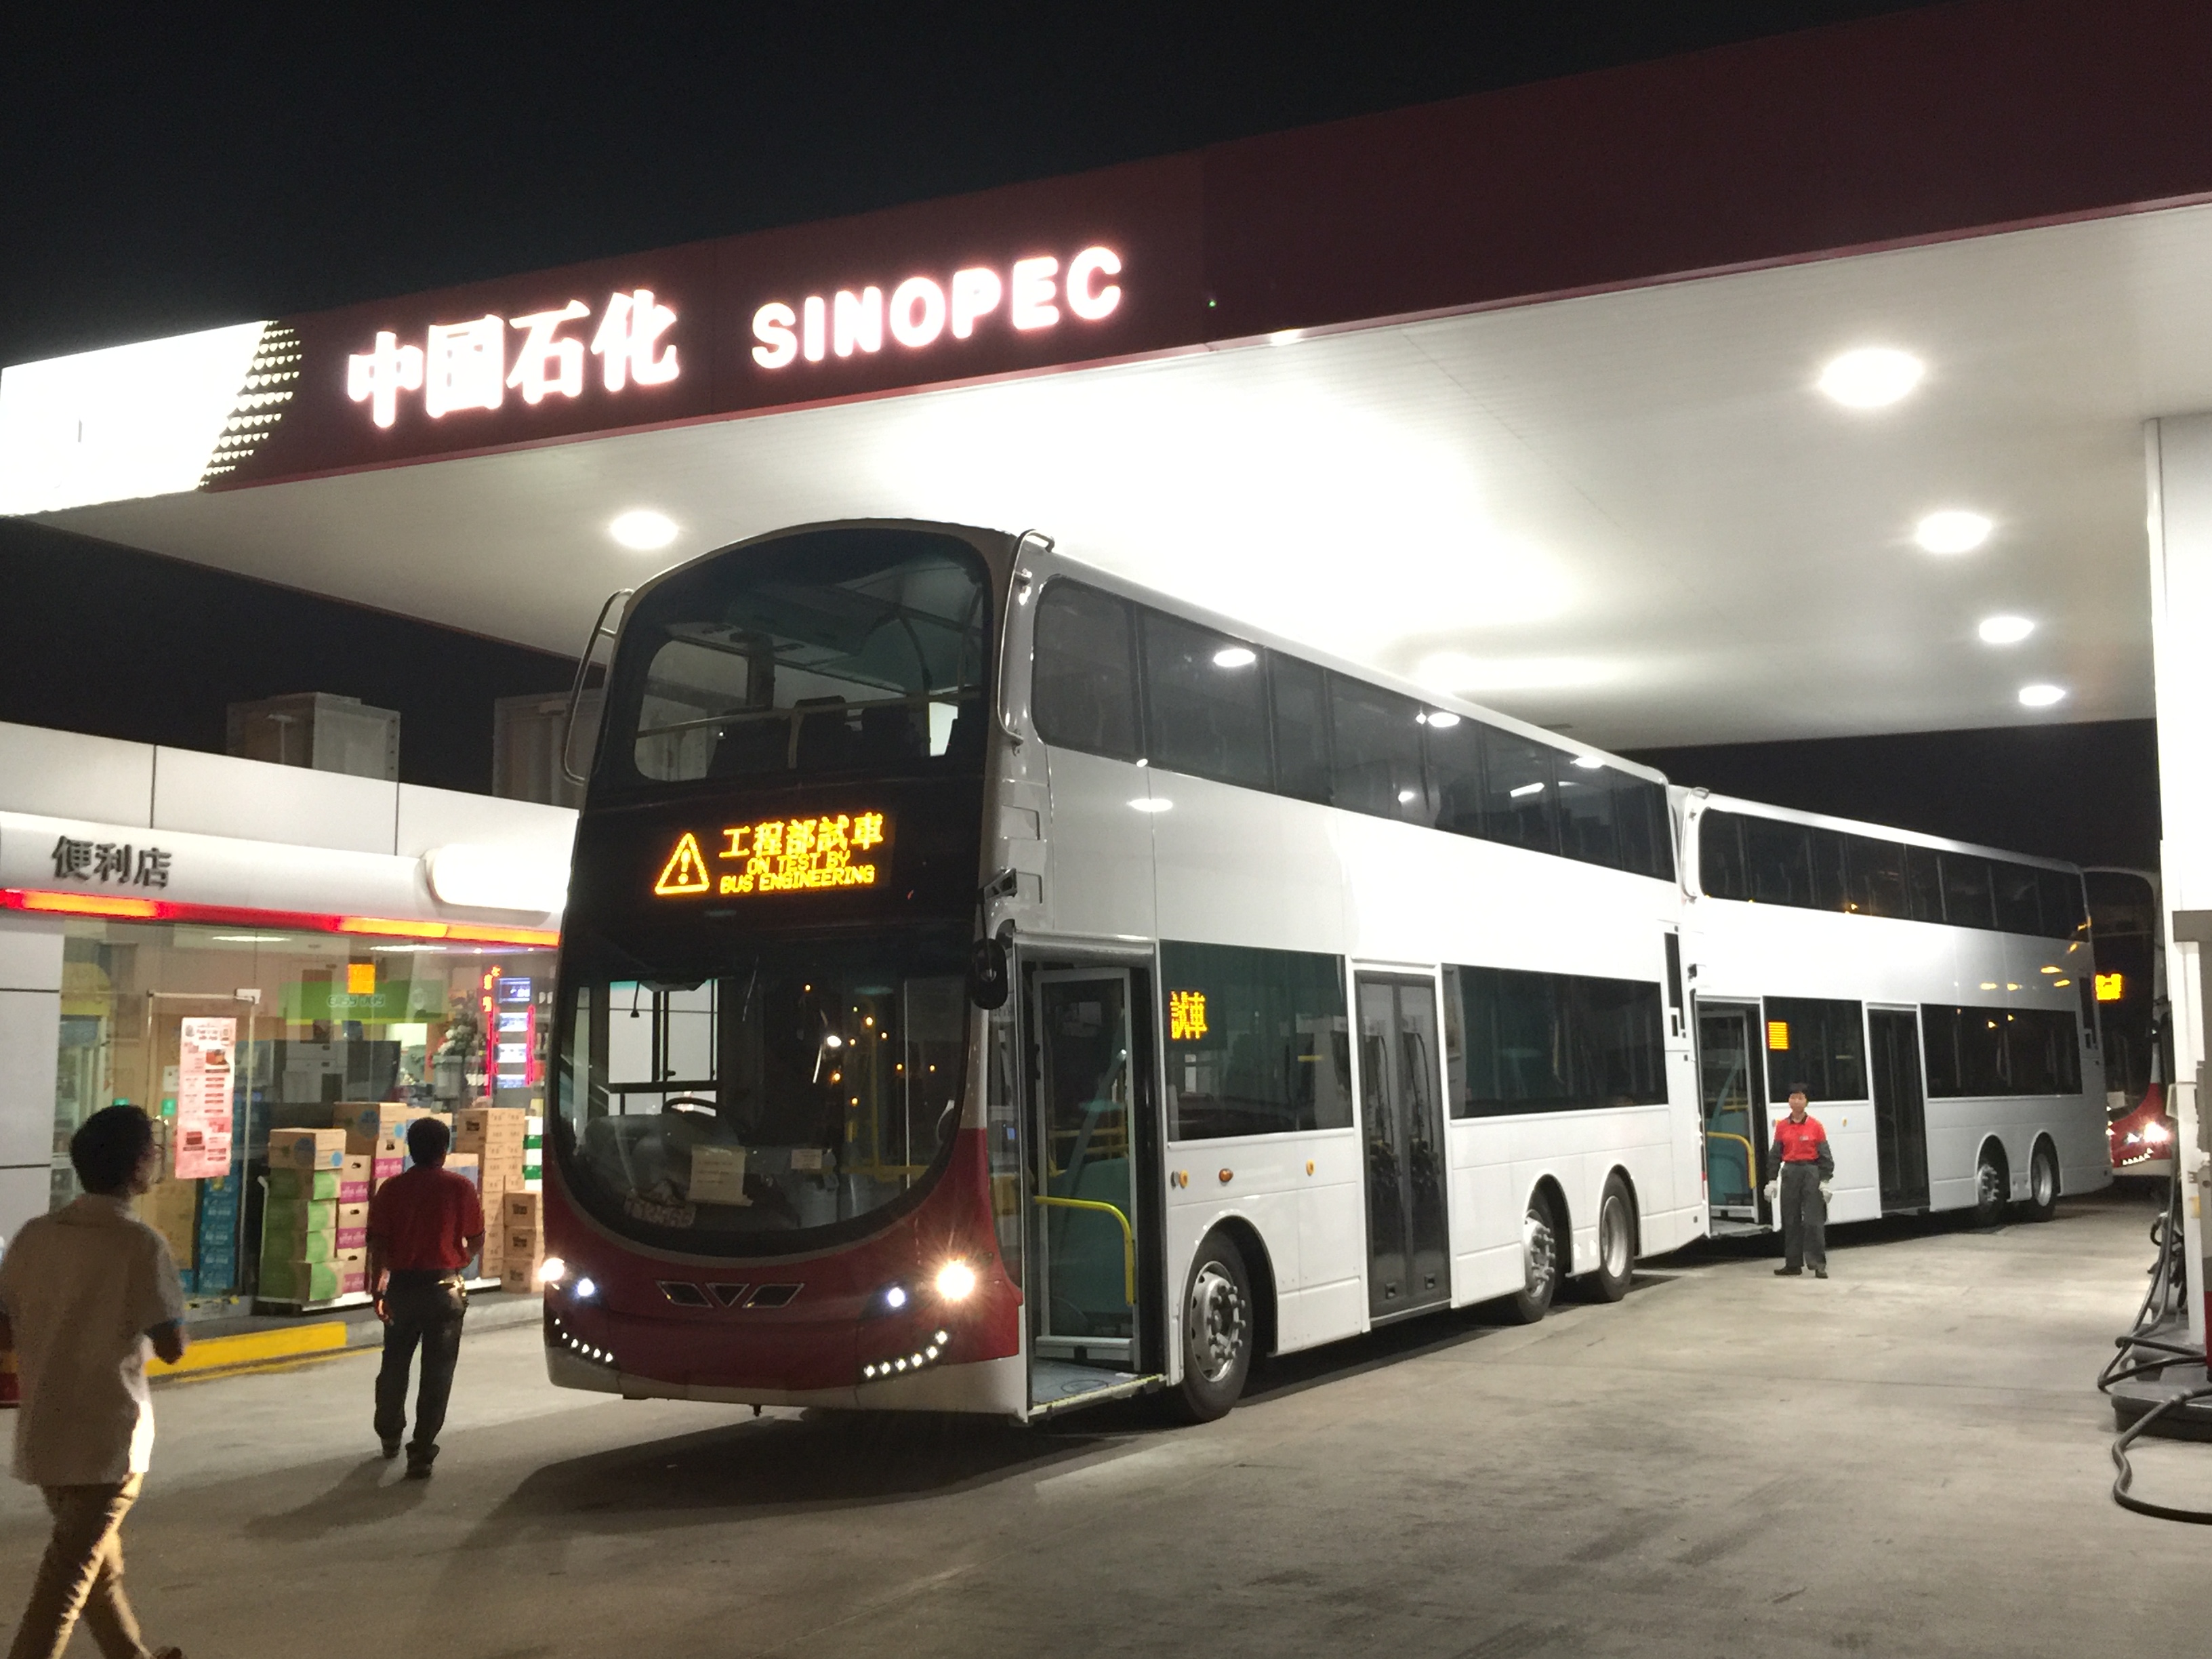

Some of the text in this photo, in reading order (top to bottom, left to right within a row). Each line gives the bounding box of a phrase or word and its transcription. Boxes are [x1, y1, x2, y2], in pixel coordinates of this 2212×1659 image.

[751, 246, 1122, 370] SINOPEC
[719, 811, 884, 858] 工程部試車
[52, 835, 171, 889] 便利店
[719, 864, 876, 894] BUS ENGINEERING
[747, 849, 851, 876] ON TEST BY
